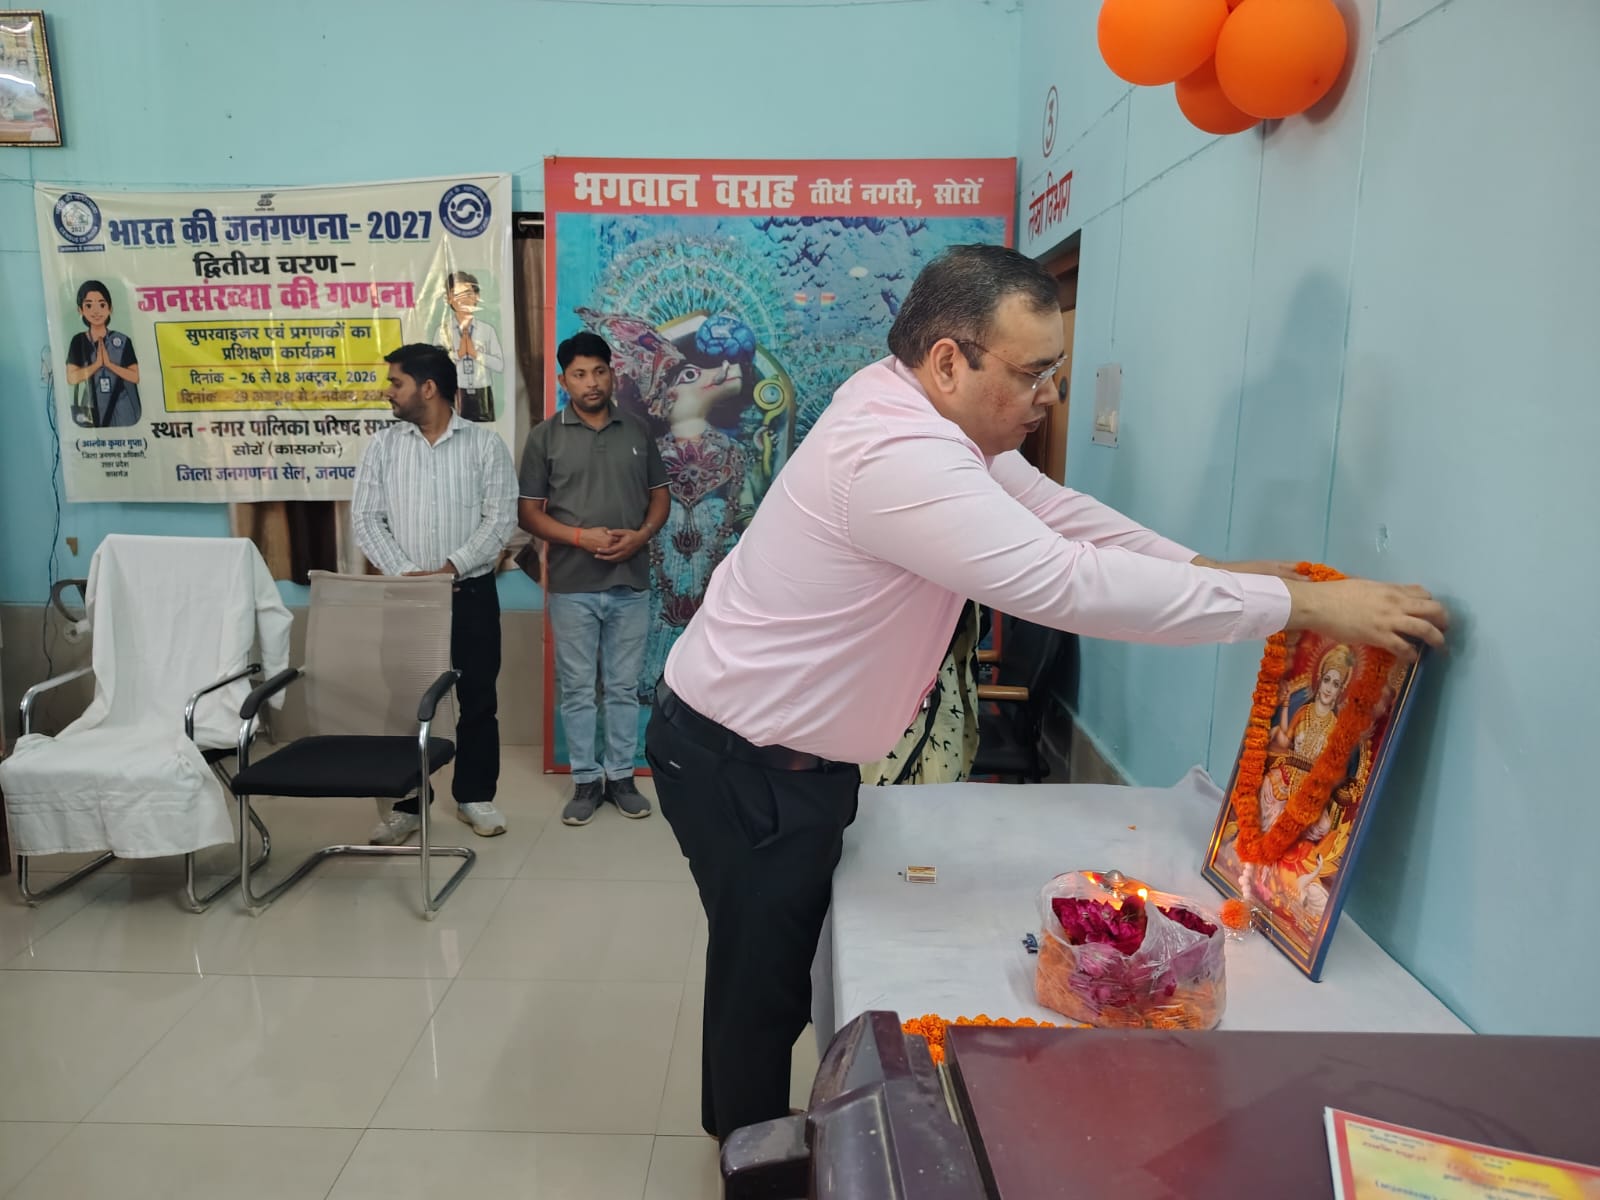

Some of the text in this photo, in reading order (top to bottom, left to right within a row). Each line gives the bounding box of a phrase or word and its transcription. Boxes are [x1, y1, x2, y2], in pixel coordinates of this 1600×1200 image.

[574, 172, 985, 209] भगवान वराह तीर्थ नगरी, सोरों
[108, 217, 174, 246] भारत
[181, 208, 218, 244] की
[367, 210, 433, 240] 2027
[193, 251, 270, 278] द्वितीय
[136, 276, 416, 313] जनसंख्या की गणना
[185, 321, 371, 345] सुपरवाइजर एवं प्रगणकों का
[222, 342, 336, 361] प्रशिक्षण कार्यक्रम
[190, 368, 223, 385] दिनांक
[241, 372, 256, 384] 26
[260, 368, 271, 383] से
[275, 372, 290, 384] 28
[295, 371, 342, 387] अक्टूबर,
[346, 371, 377, 383] 2026
[180, 388, 217, 404] दिनांक
[150, 421, 194, 439] स्थान
[210, 420, 244, 438] नगर
[249, 415, 310, 437] पालिका
[314, 415, 361, 437] परिषद
[232, 440, 343, 459] सोरों (कासगंज)
[176, 464, 212, 482] जिला
[215, 465, 278, 482] जनगणना
[281, 463, 311, 483] सेल,
